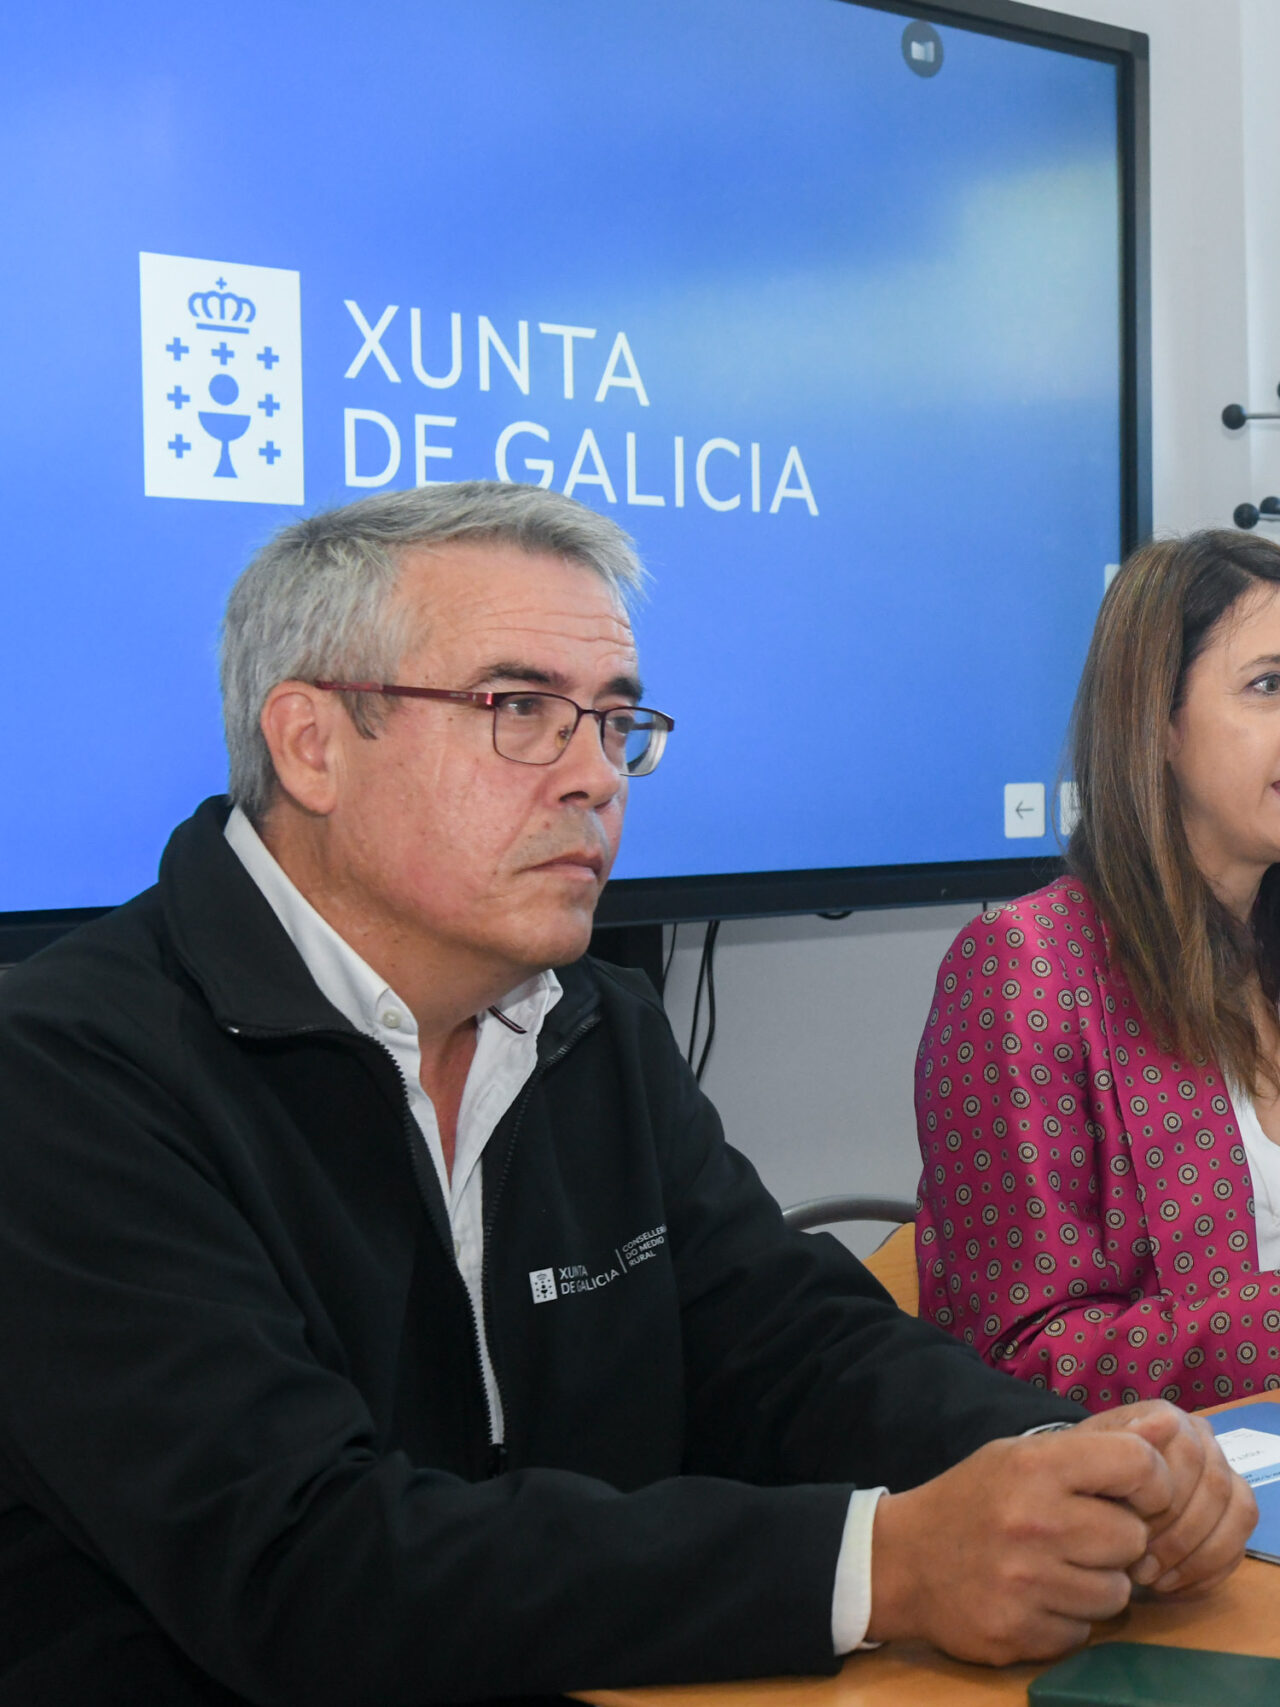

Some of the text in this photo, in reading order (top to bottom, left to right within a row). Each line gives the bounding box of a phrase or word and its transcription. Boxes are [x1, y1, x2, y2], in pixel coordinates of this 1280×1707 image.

[344, 299, 650, 407] XUNTA
[344, 407, 820, 517] DE GALICIA
[625, 1235, 665, 1260] DO MEDIO
[628, 1250, 657, 1267] RURAL
[558, 1265, 589, 1280] XUNTA
[560, 1268, 620, 1295] DE GALICIA
